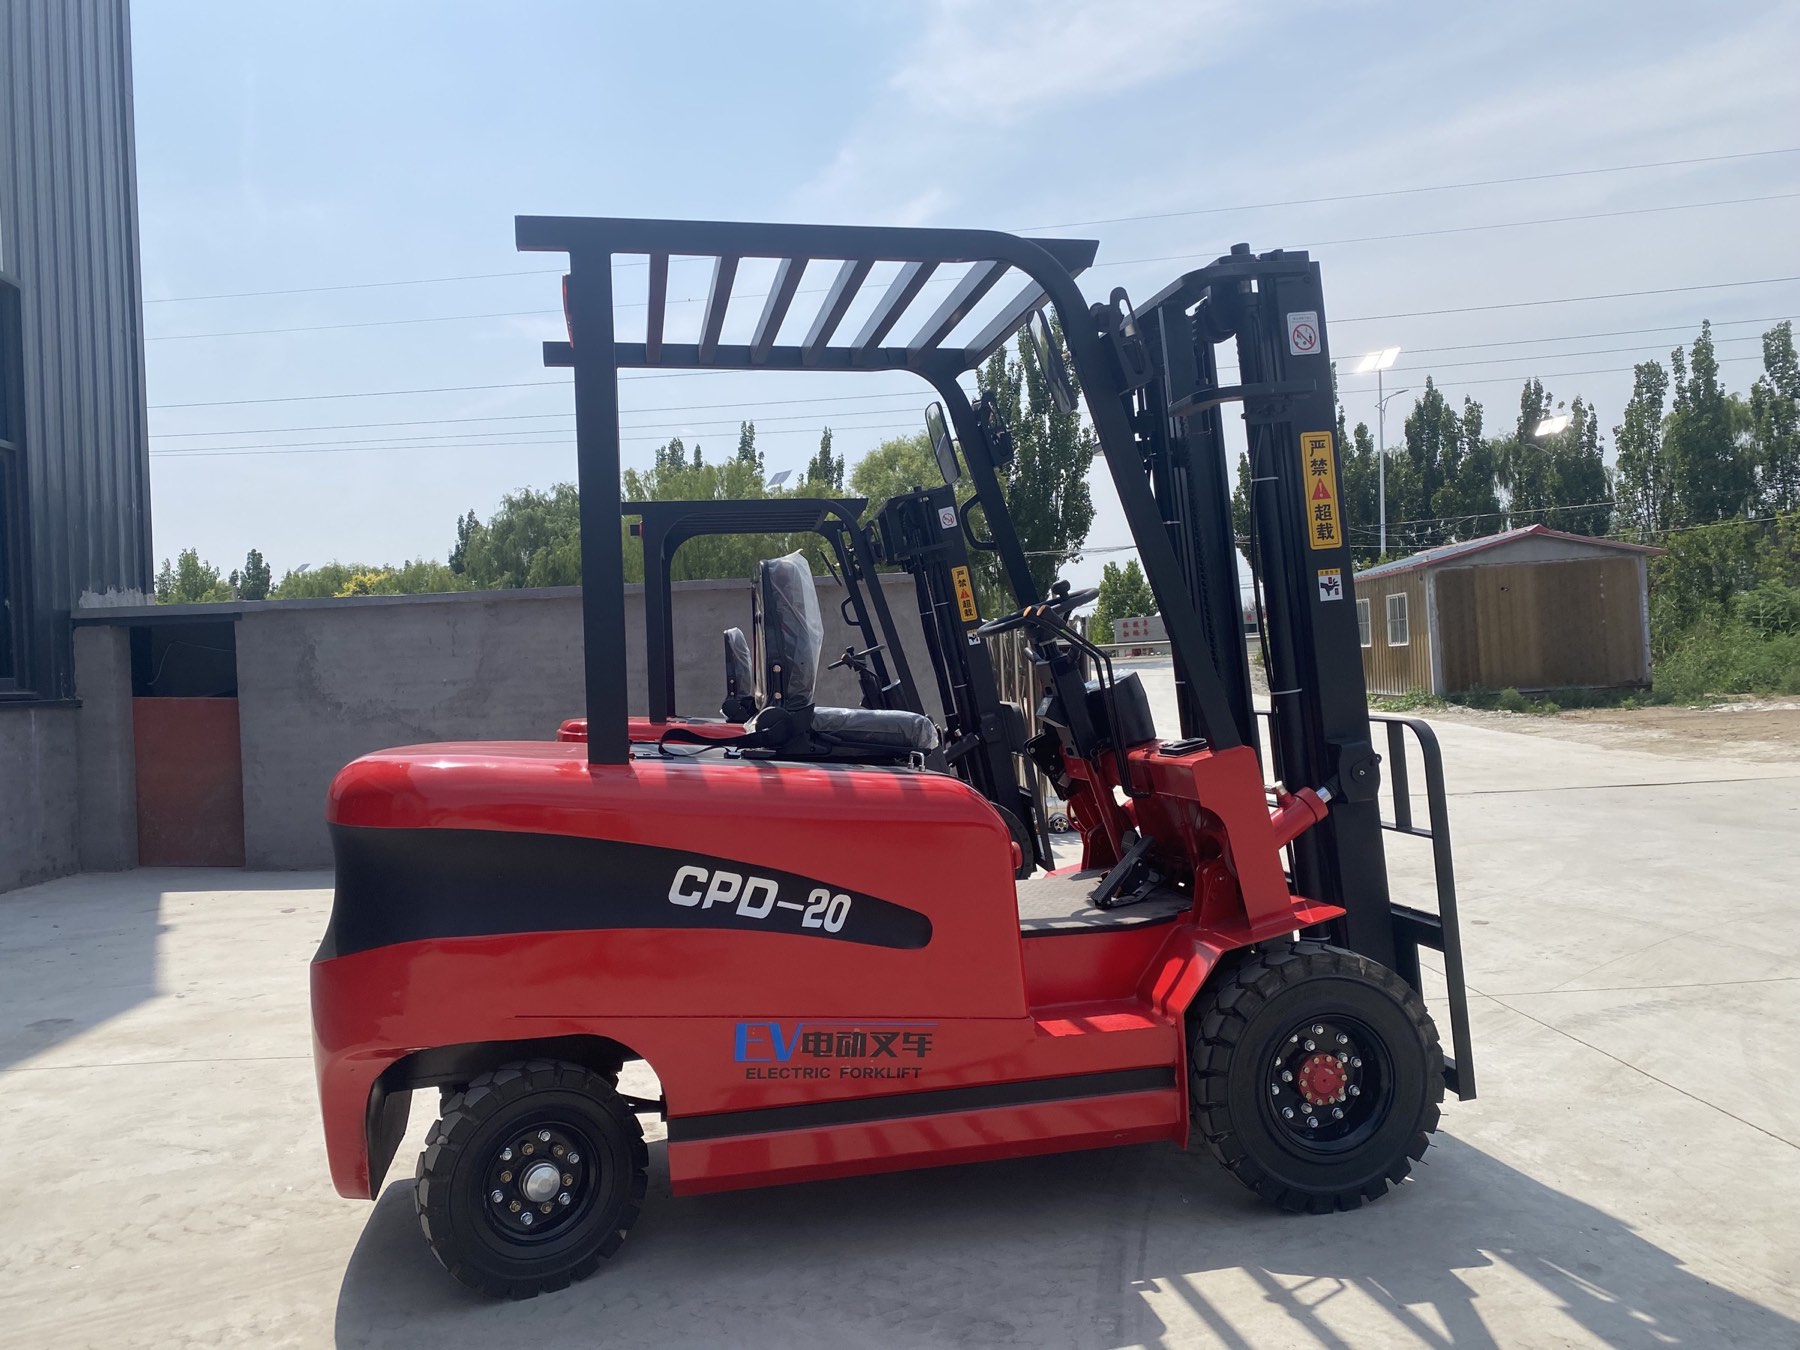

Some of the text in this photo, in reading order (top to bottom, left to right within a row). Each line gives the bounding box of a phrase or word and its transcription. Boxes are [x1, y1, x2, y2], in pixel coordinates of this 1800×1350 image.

[668, 865, 852, 933] CPD-20
[734, 1022, 803, 1062] EV
[745, 1066, 923, 1080] ELECTRIC FORKLIFT
